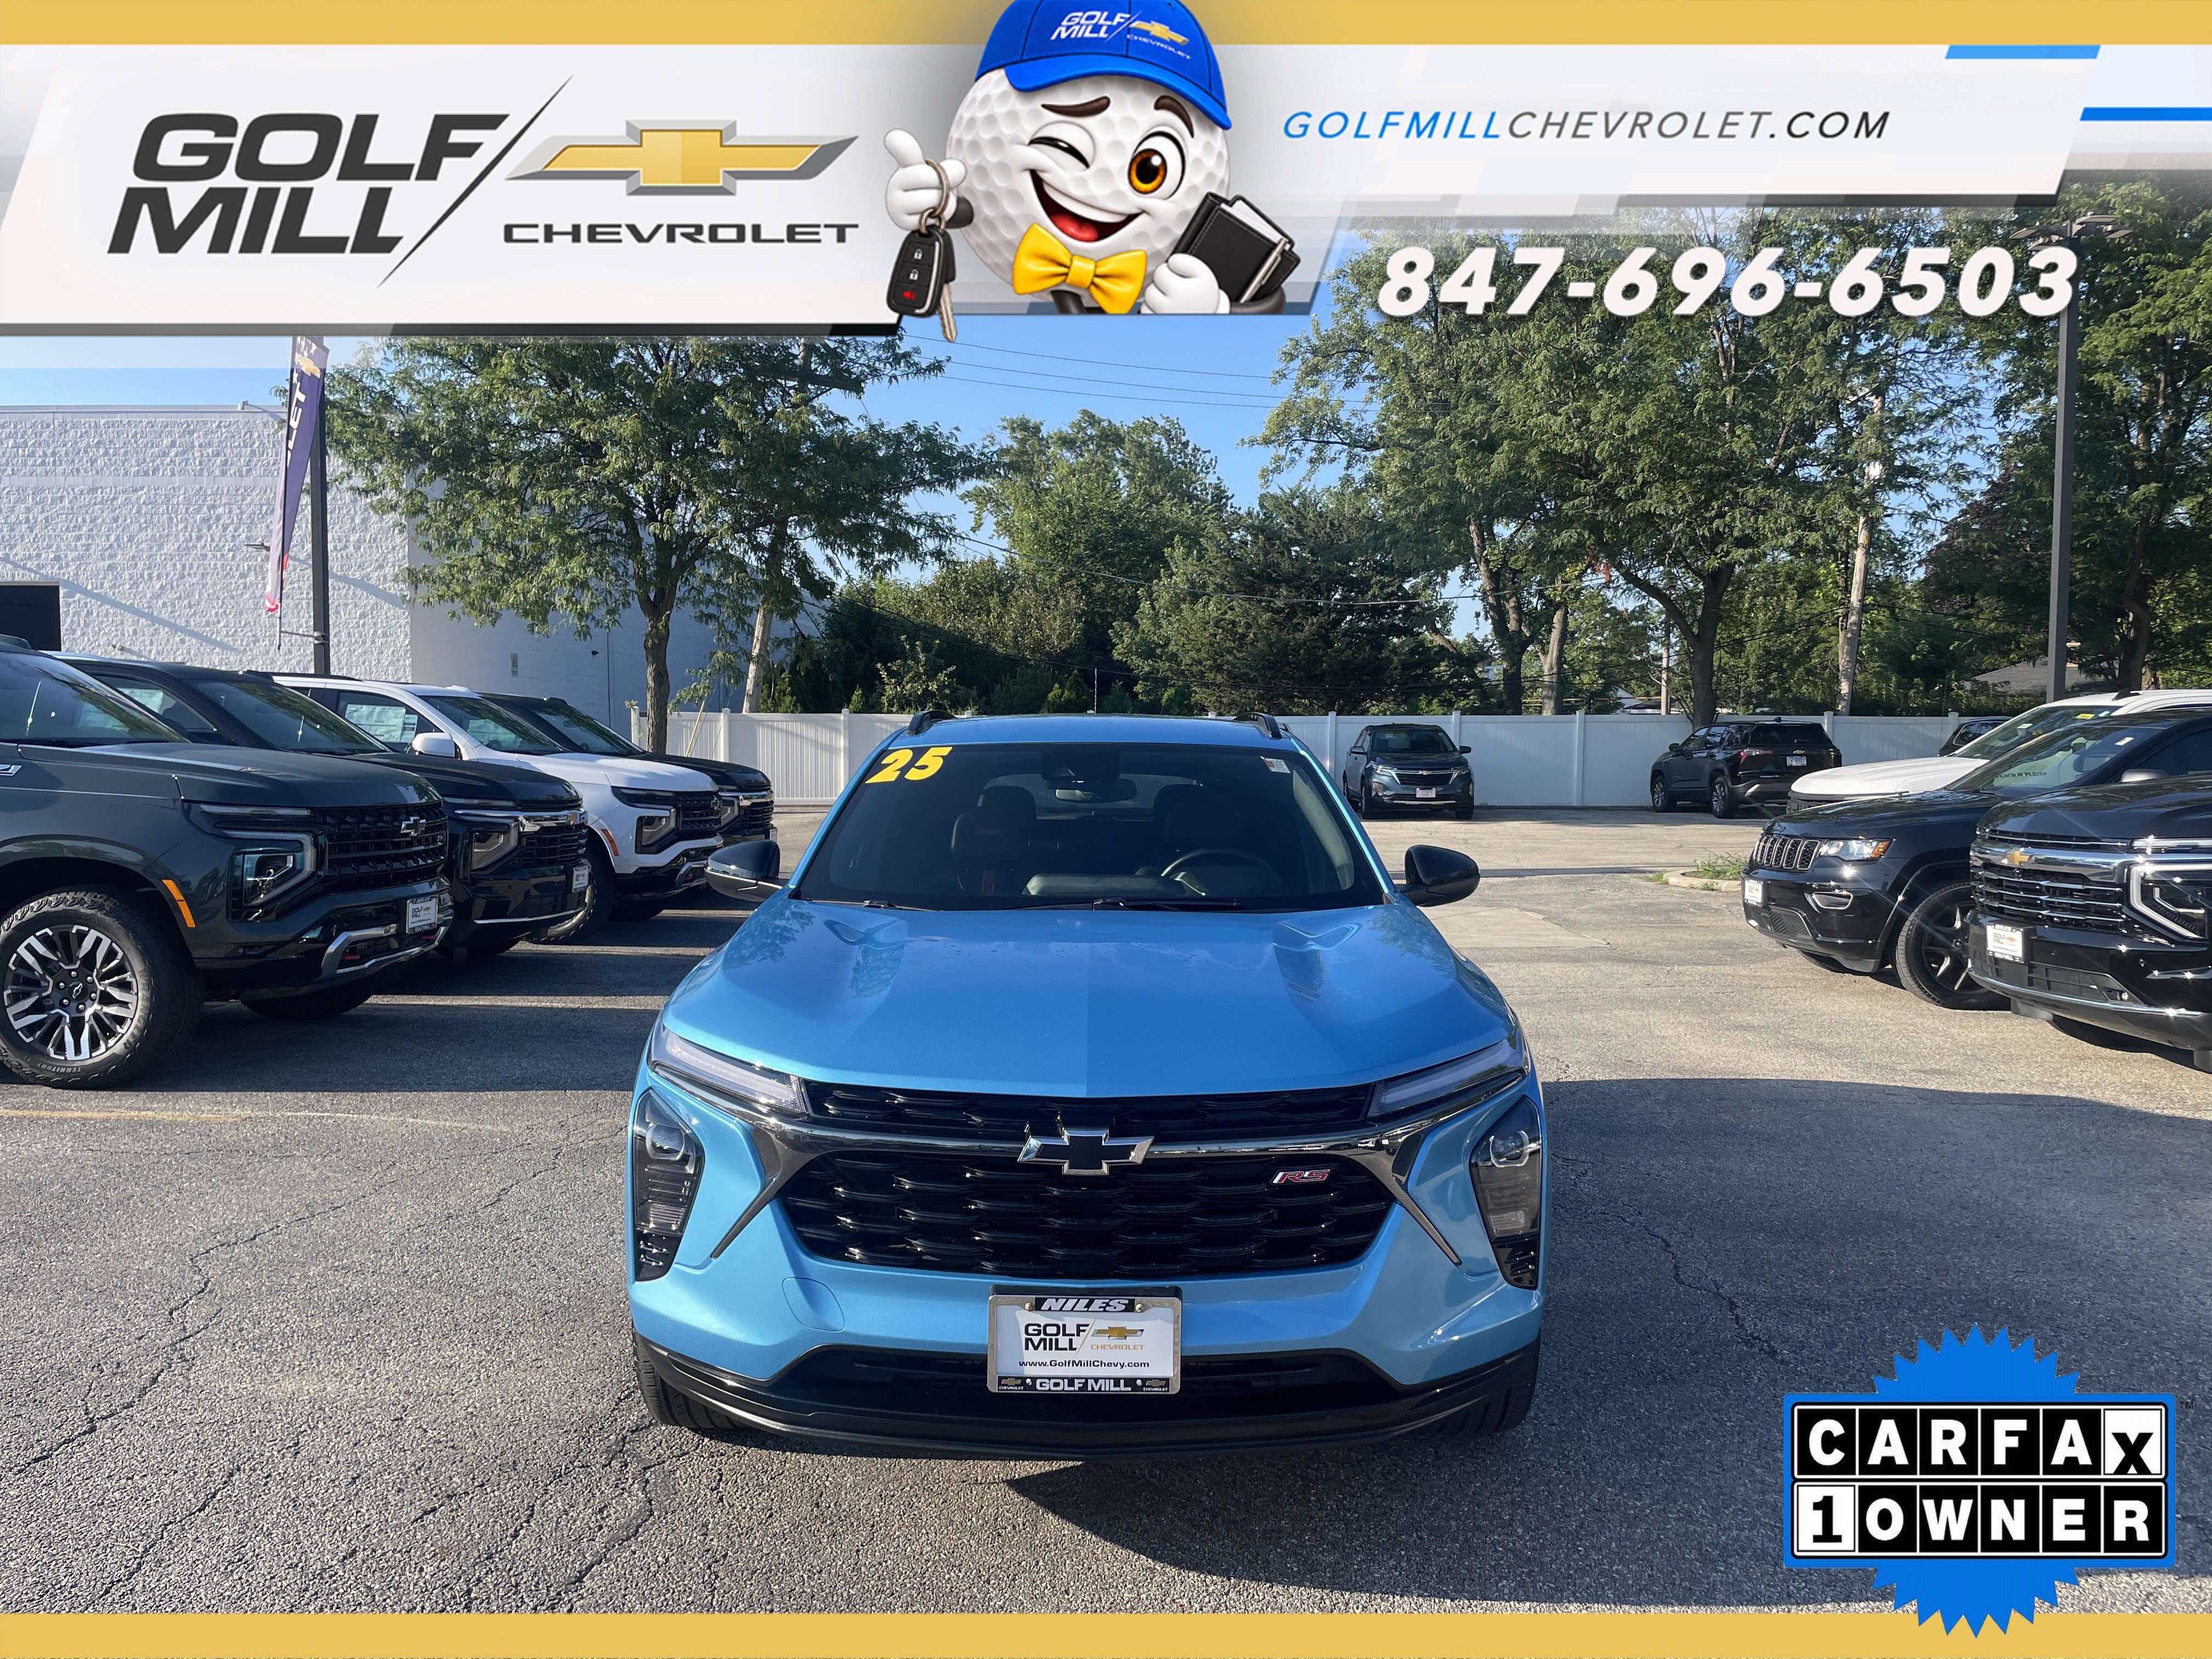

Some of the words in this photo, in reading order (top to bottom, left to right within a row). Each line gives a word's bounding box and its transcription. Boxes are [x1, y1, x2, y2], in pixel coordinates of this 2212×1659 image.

[865, 747, 953, 784] 25
[1272, 1169, 1330, 1184] RS
[1040, 1298, 1128, 1312] NILES
[1024, 1323, 1090, 1337] GOLF
[1024, 1337, 1077, 1351] MILL
[1018, 1359, 1149, 1369] www.GolfMillChevy.com
[1036, 1378, 1086, 1391] GOLF
[1087, 1379, 1132, 1391] MILL
